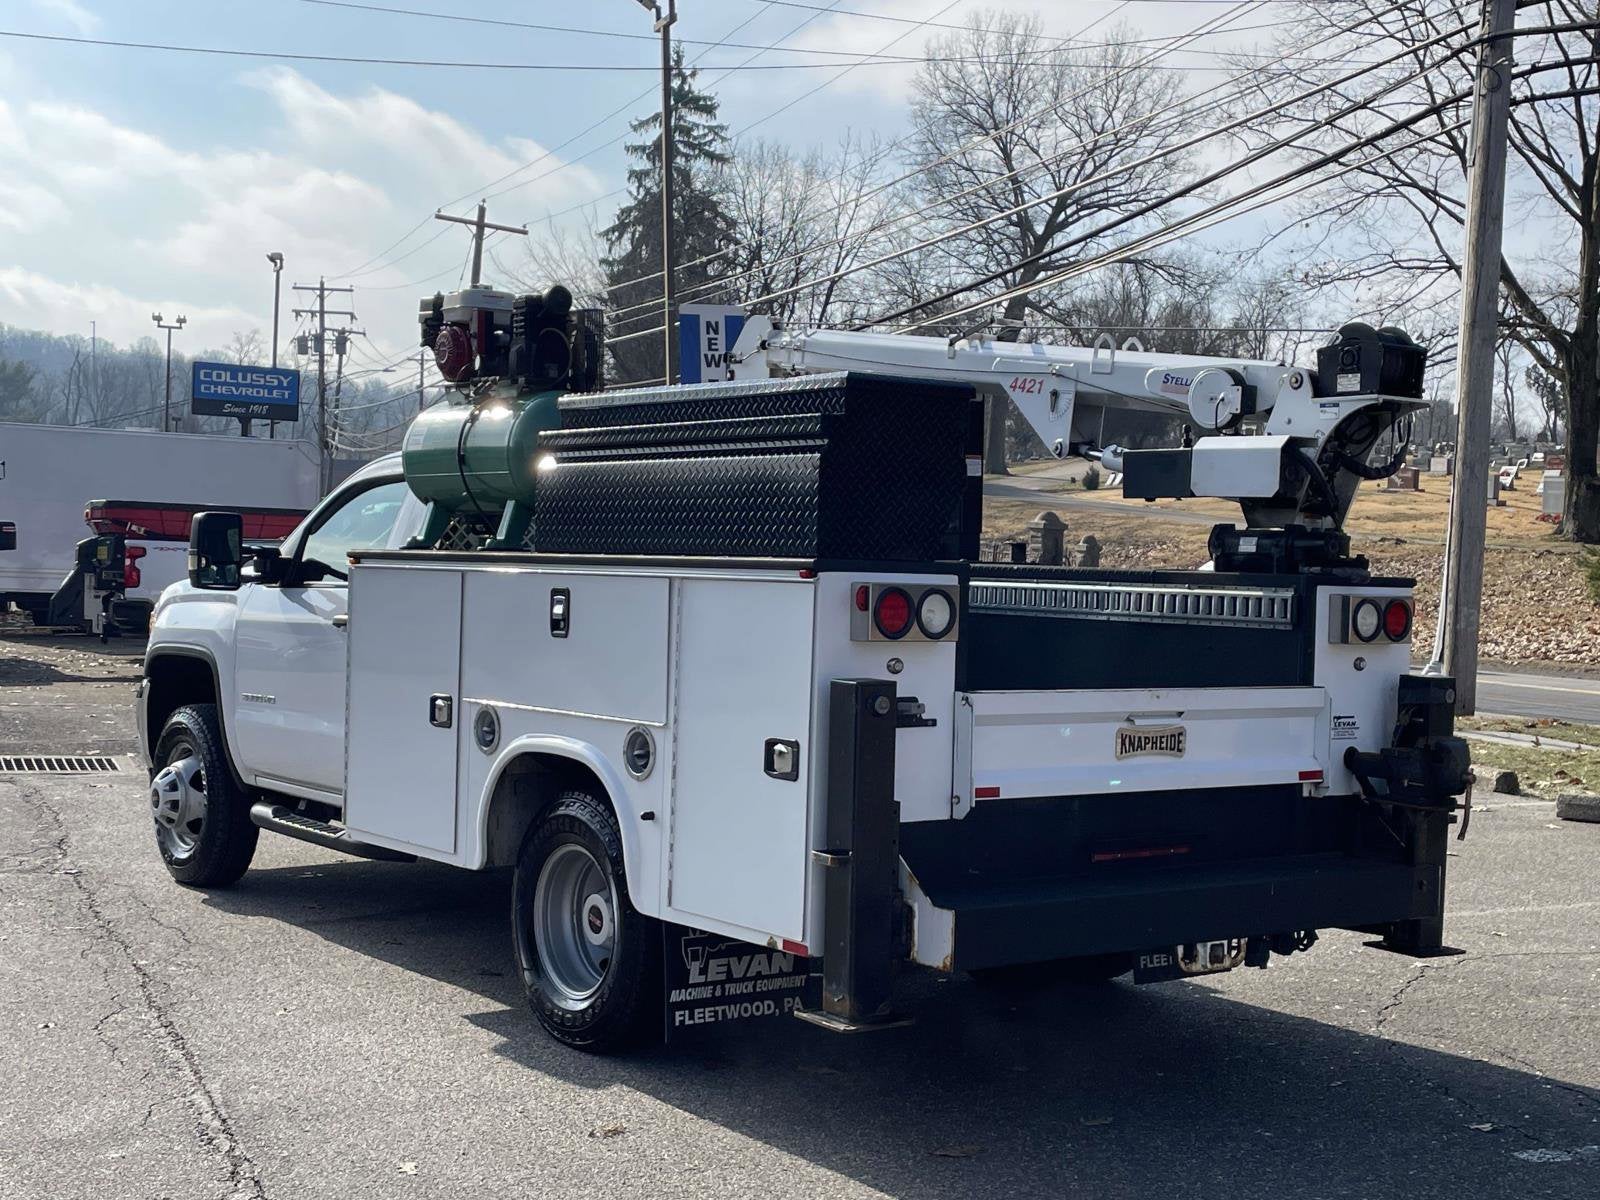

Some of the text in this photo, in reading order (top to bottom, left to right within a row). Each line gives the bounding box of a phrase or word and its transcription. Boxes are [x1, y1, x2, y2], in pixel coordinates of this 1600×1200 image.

[704, 320, 722, 368] NEW
[200, 369, 292, 387] COLUSSY
[1010, 377, 1044, 394] 4421
[200, 384, 292, 399] CHEVROLET
[222, 403, 269, 415] Since 1918
[1120, 731, 1184, 755] KNAPHEIDE
[688, 952, 794, 984] LEVAN
[669, 975, 807, 1003] MACHINE & TRUCK EQUIPMENT
[674, 995, 804, 1026] FLEETWOOD, PA
